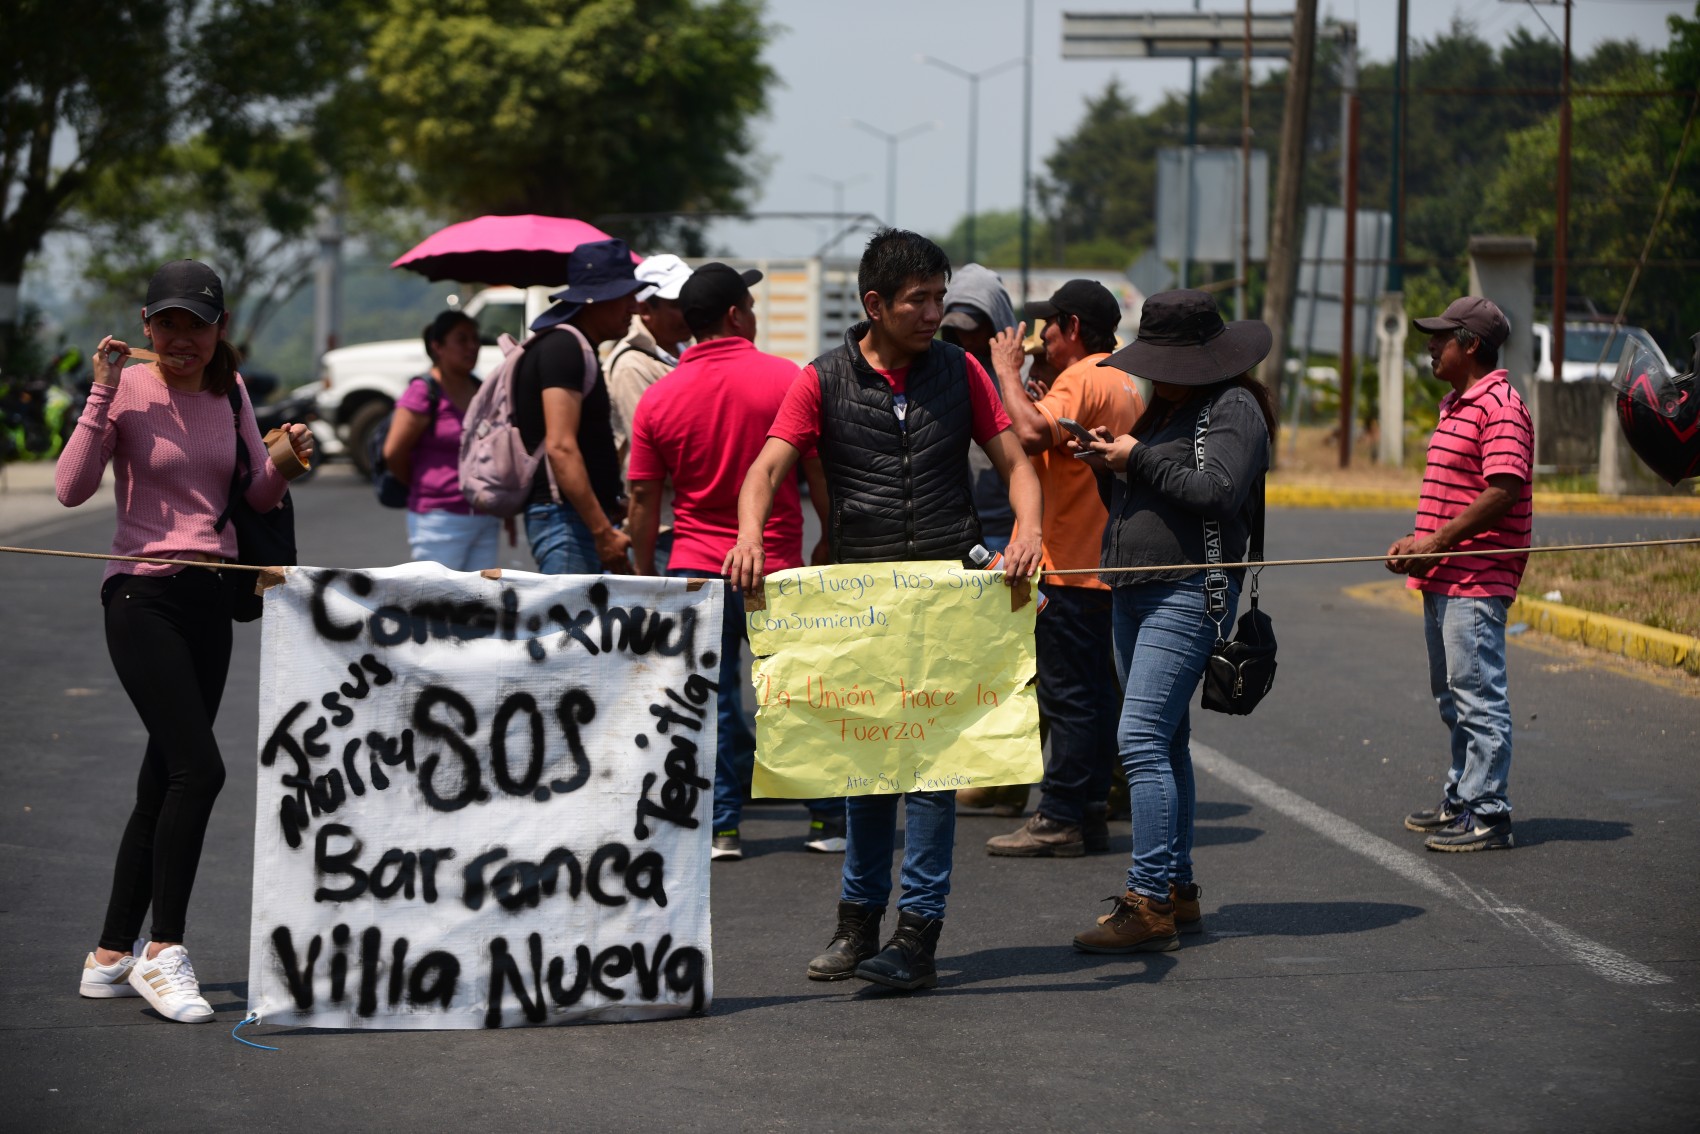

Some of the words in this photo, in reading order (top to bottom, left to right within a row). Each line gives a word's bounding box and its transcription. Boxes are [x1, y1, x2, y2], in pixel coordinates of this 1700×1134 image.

[779, 572, 802, 596] el
[807, 675, 875, 709] Unión
[900, 677, 957, 708] hace
[977, 683, 999, 707] la
[879, 772, 900, 790] Su
[914, 770, 972, 791] Servidor
[315, 823, 668, 910] Barranca
[271, 924, 461, 1018] Villa
[486, 932, 705, 1028] Nueva
